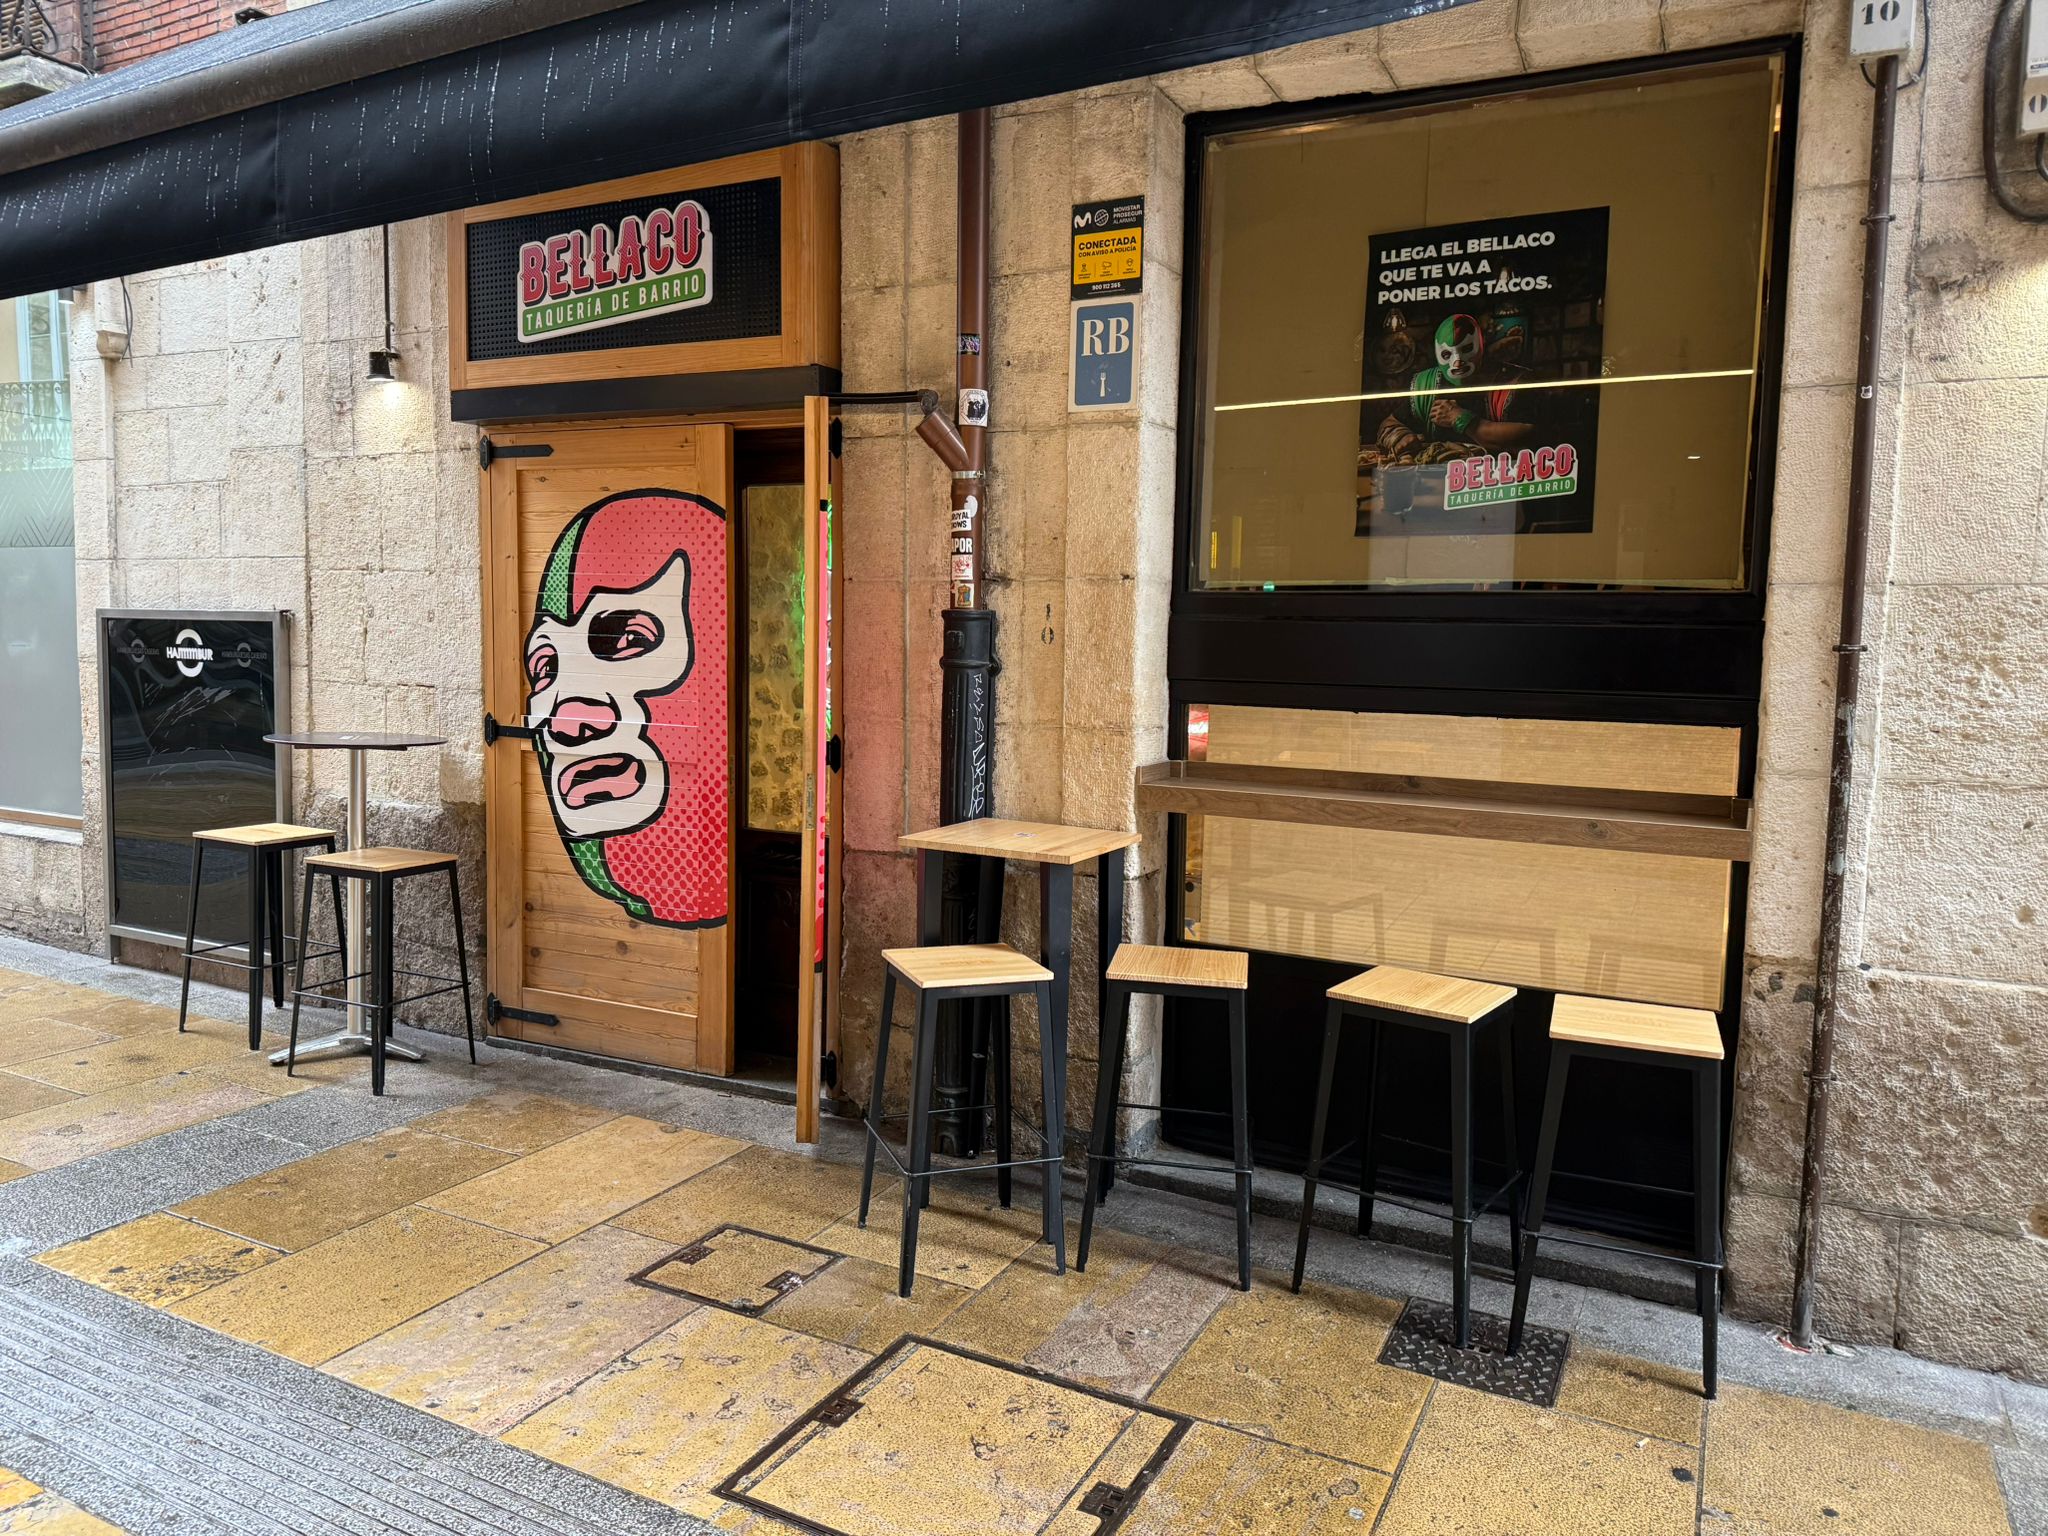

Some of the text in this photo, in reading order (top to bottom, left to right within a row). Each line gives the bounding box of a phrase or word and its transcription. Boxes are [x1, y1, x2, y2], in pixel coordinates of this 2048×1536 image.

[1861, 0, 1900, 25] 10
[1112, 209, 1143, 219] PROSEGUR
[1113, 204, 1141, 213] MOVISTAR
[520, 202, 704, 306] BELLACO
[1078, 236, 1137, 251] CONECTADA
[1091, 248, 1109, 256] AVISO
[1380, 231, 1556, 265] LLEGA EL BELLACO
[1378, 259, 1492, 287] QUE TE VA A
[526, 274, 699, 331] TAQUERÍA DE BARRIO
[1377, 275, 1553, 305] PONER LOS TACOS.
[1081, 316, 1130, 357] RB
[1447, 444, 1576, 493] BELLACO
[1450, 479, 1571, 505] TAQUERÍA DE BARRIO
